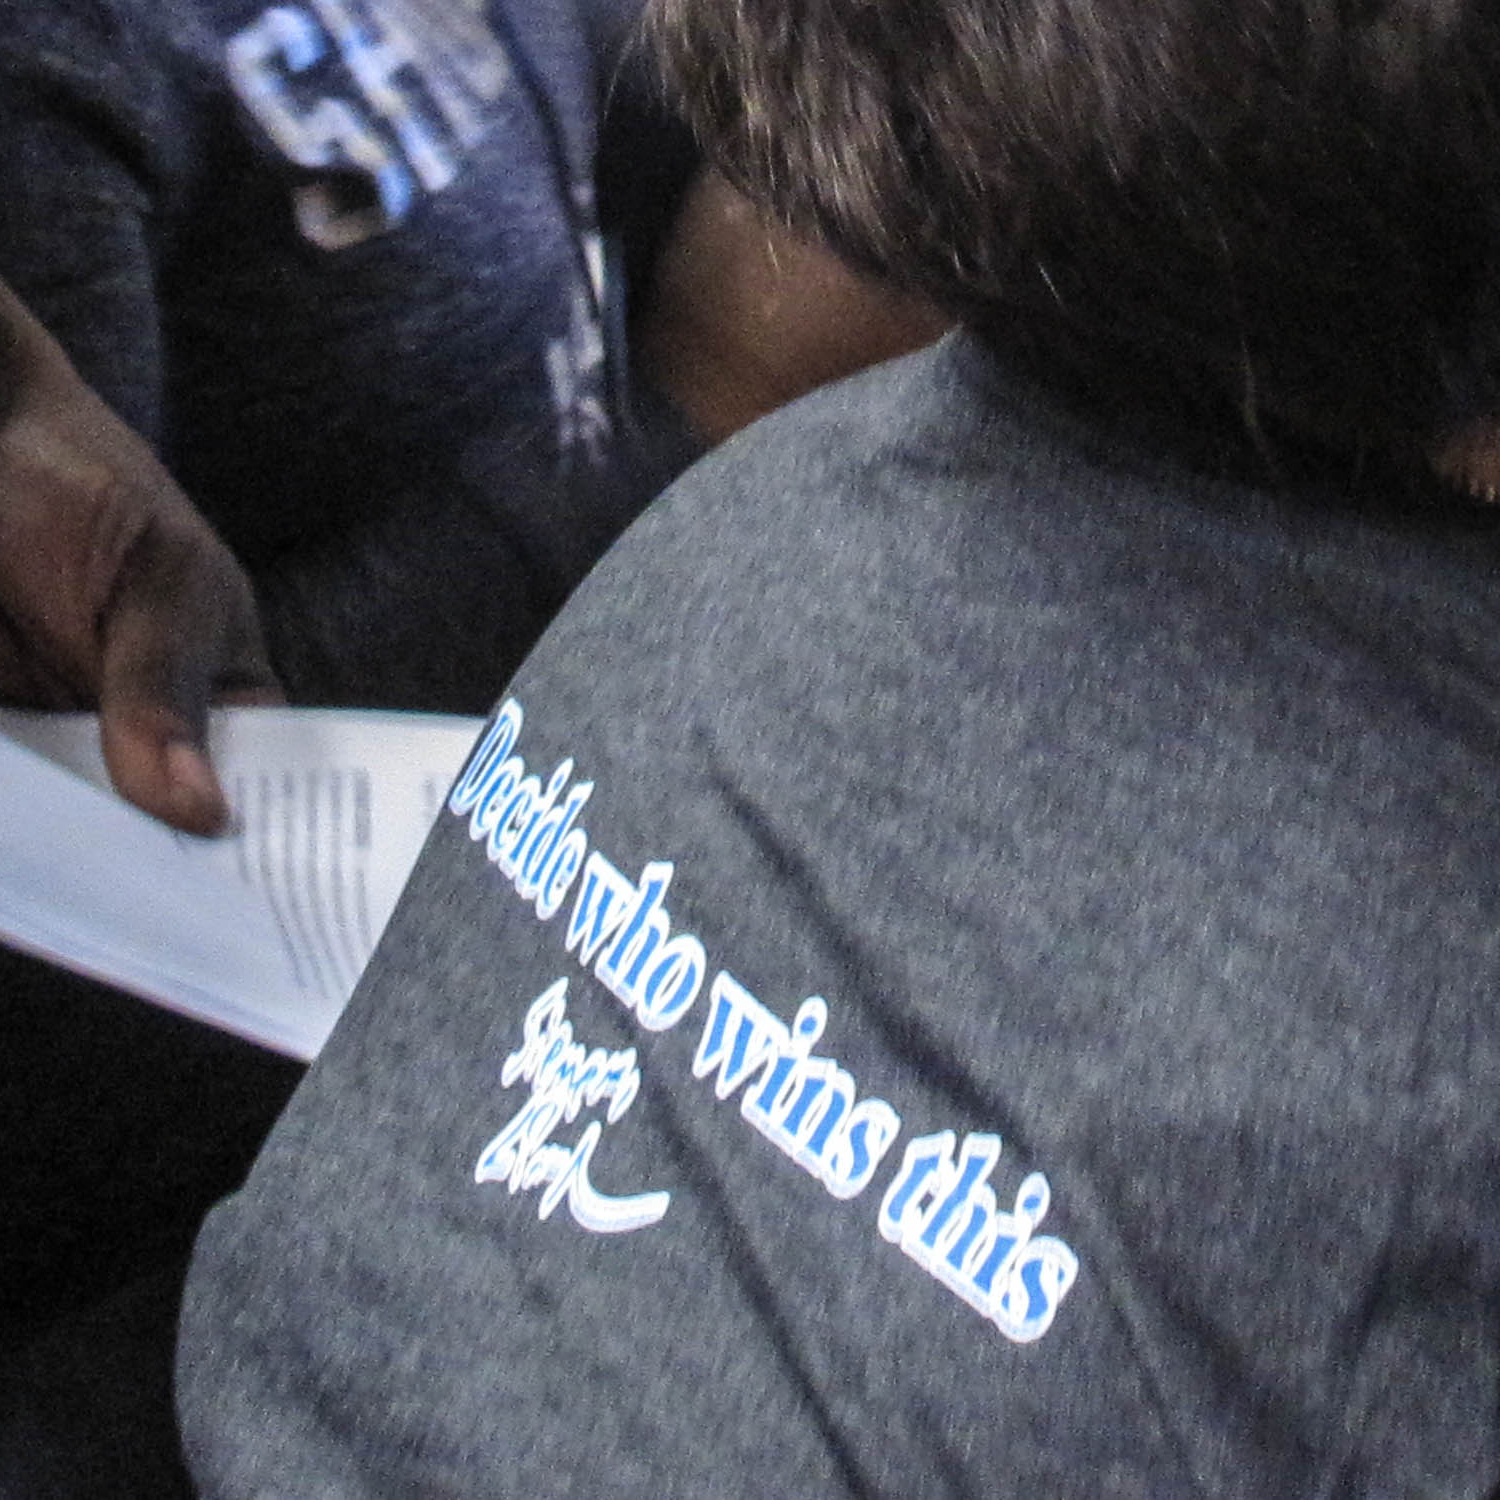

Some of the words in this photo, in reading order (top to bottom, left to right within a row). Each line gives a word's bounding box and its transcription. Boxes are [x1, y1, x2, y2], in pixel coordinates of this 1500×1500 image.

[450, 697, 595, 920] Decide
[566, 851, 707, 1032] who
[691, 970, 902, 1200] wins
[878, 1129, 1080, 1344] this
